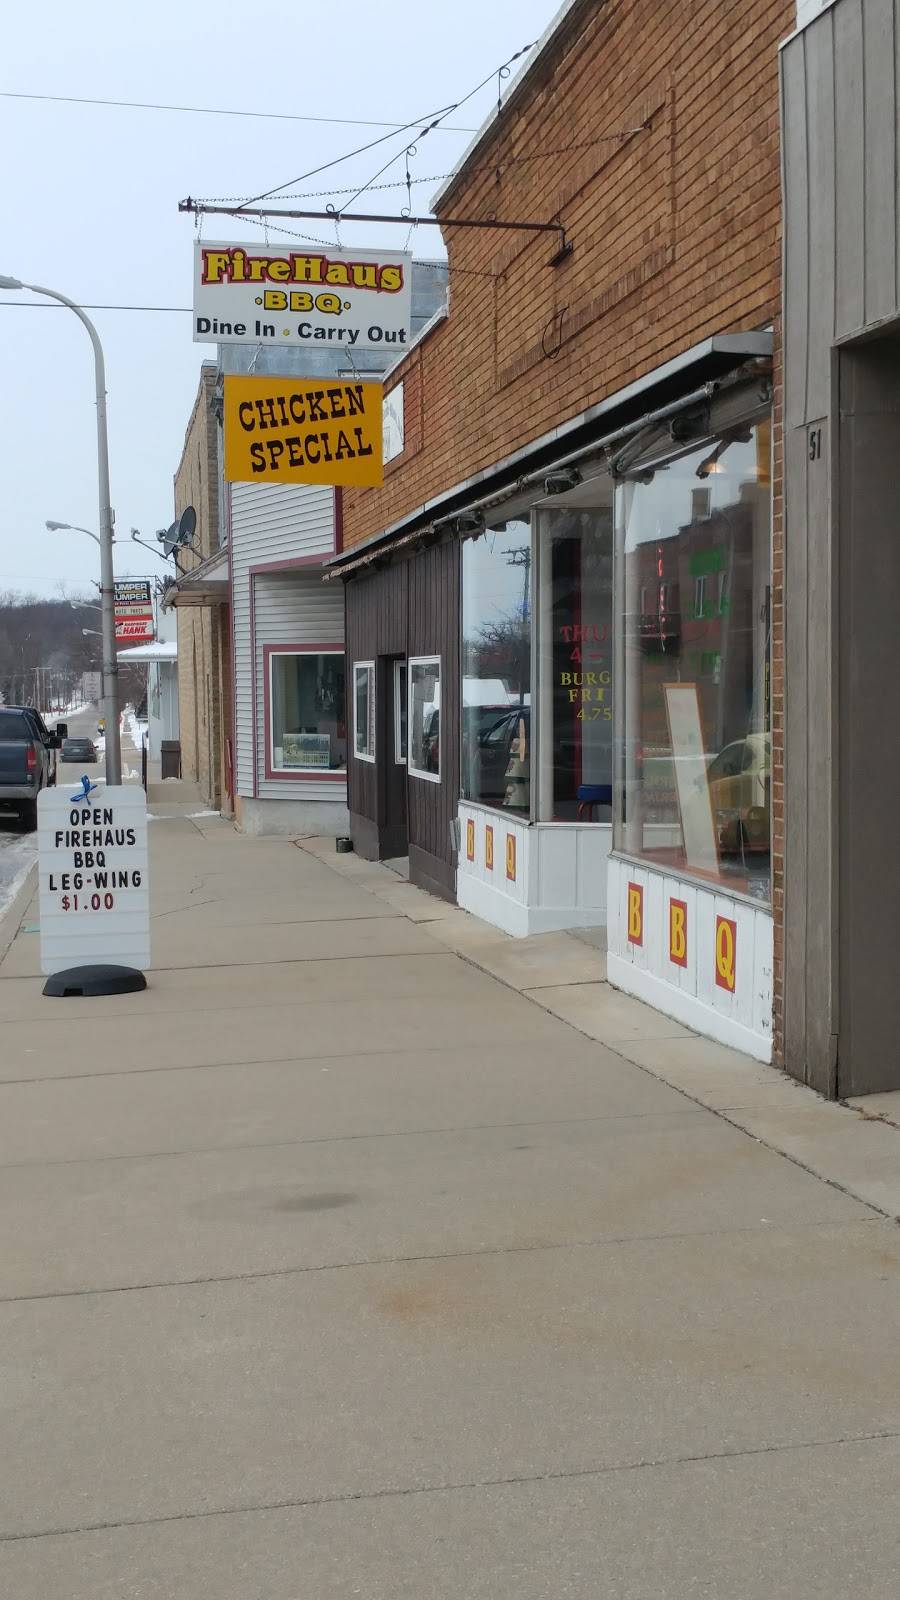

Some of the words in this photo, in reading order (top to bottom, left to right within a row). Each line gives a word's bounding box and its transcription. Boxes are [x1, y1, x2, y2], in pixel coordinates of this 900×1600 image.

[202, 248, 404, 294] FireHaus
[264, 290, 343, 316] BBQ
[196, 317, 247, 336] Dine
[255, 320, 276, 337] In
[297, 322, 360, 344] Carry
[367, 325, 407, 343] Out
[238, 384, 365, 432] CHICKEN
[250, 427, 373, 473] SPECIAL
[114, 583, 148, 592] UMPER
[113, 593, 149, 601] UMPER
[123, 626, 147, 635] HANK
[560, 670, 611, 686] BURG
[567, 687, 605, 703] FRI
[576, 707, 613, 721] 4.75
[70, 808, 114, 826] OPEN
[55, 828, 136, 848] FIREHAUS
[74, 851, 106, 868] BBQ
[49, 870, 142, 891] LEG-WING
[61, 893, 114, 912] $1.00
